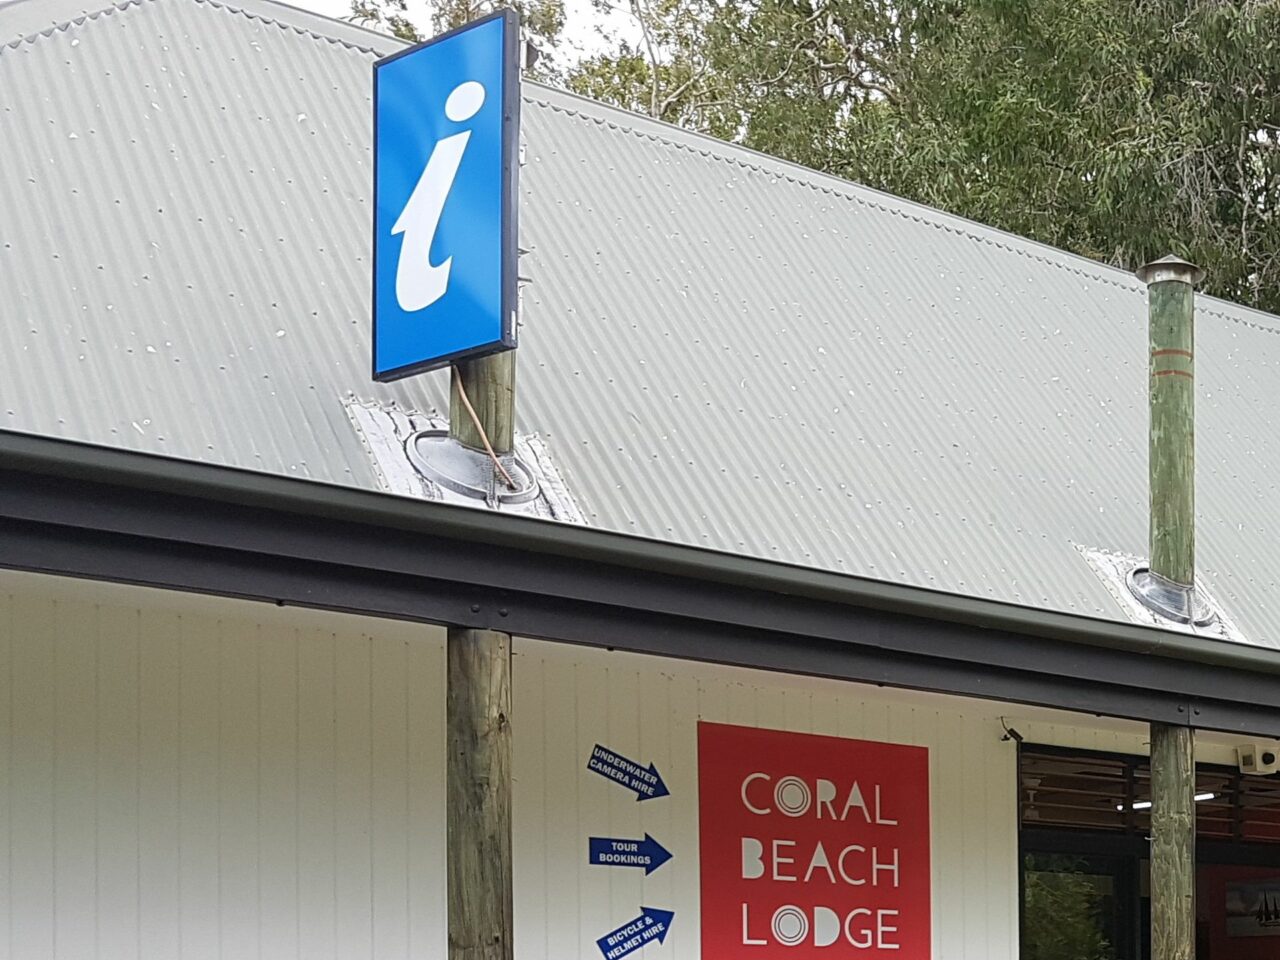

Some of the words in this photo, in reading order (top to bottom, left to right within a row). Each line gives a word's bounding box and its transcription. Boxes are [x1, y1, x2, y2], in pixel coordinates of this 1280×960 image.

[590, 760, 630, 783] CAMERA
[631, 778, 655, 795] HIRE
[594, 748, 658, 785] UNDERWATER
[741, 773, 898, 825] CORAL
[600, 854, 651, 864] BOOKINGS
[612, 843, 637, 851] TOUR
[742, 837, 898, 887] BEACH
[607, 921, 645, 946] BICYCLE
[645, 916, 654, 925] &
[607, 934, 642, 960] HELMET
[644, 923, 665, 942] HIRE
[743, 903, 900, 949] LODGE
